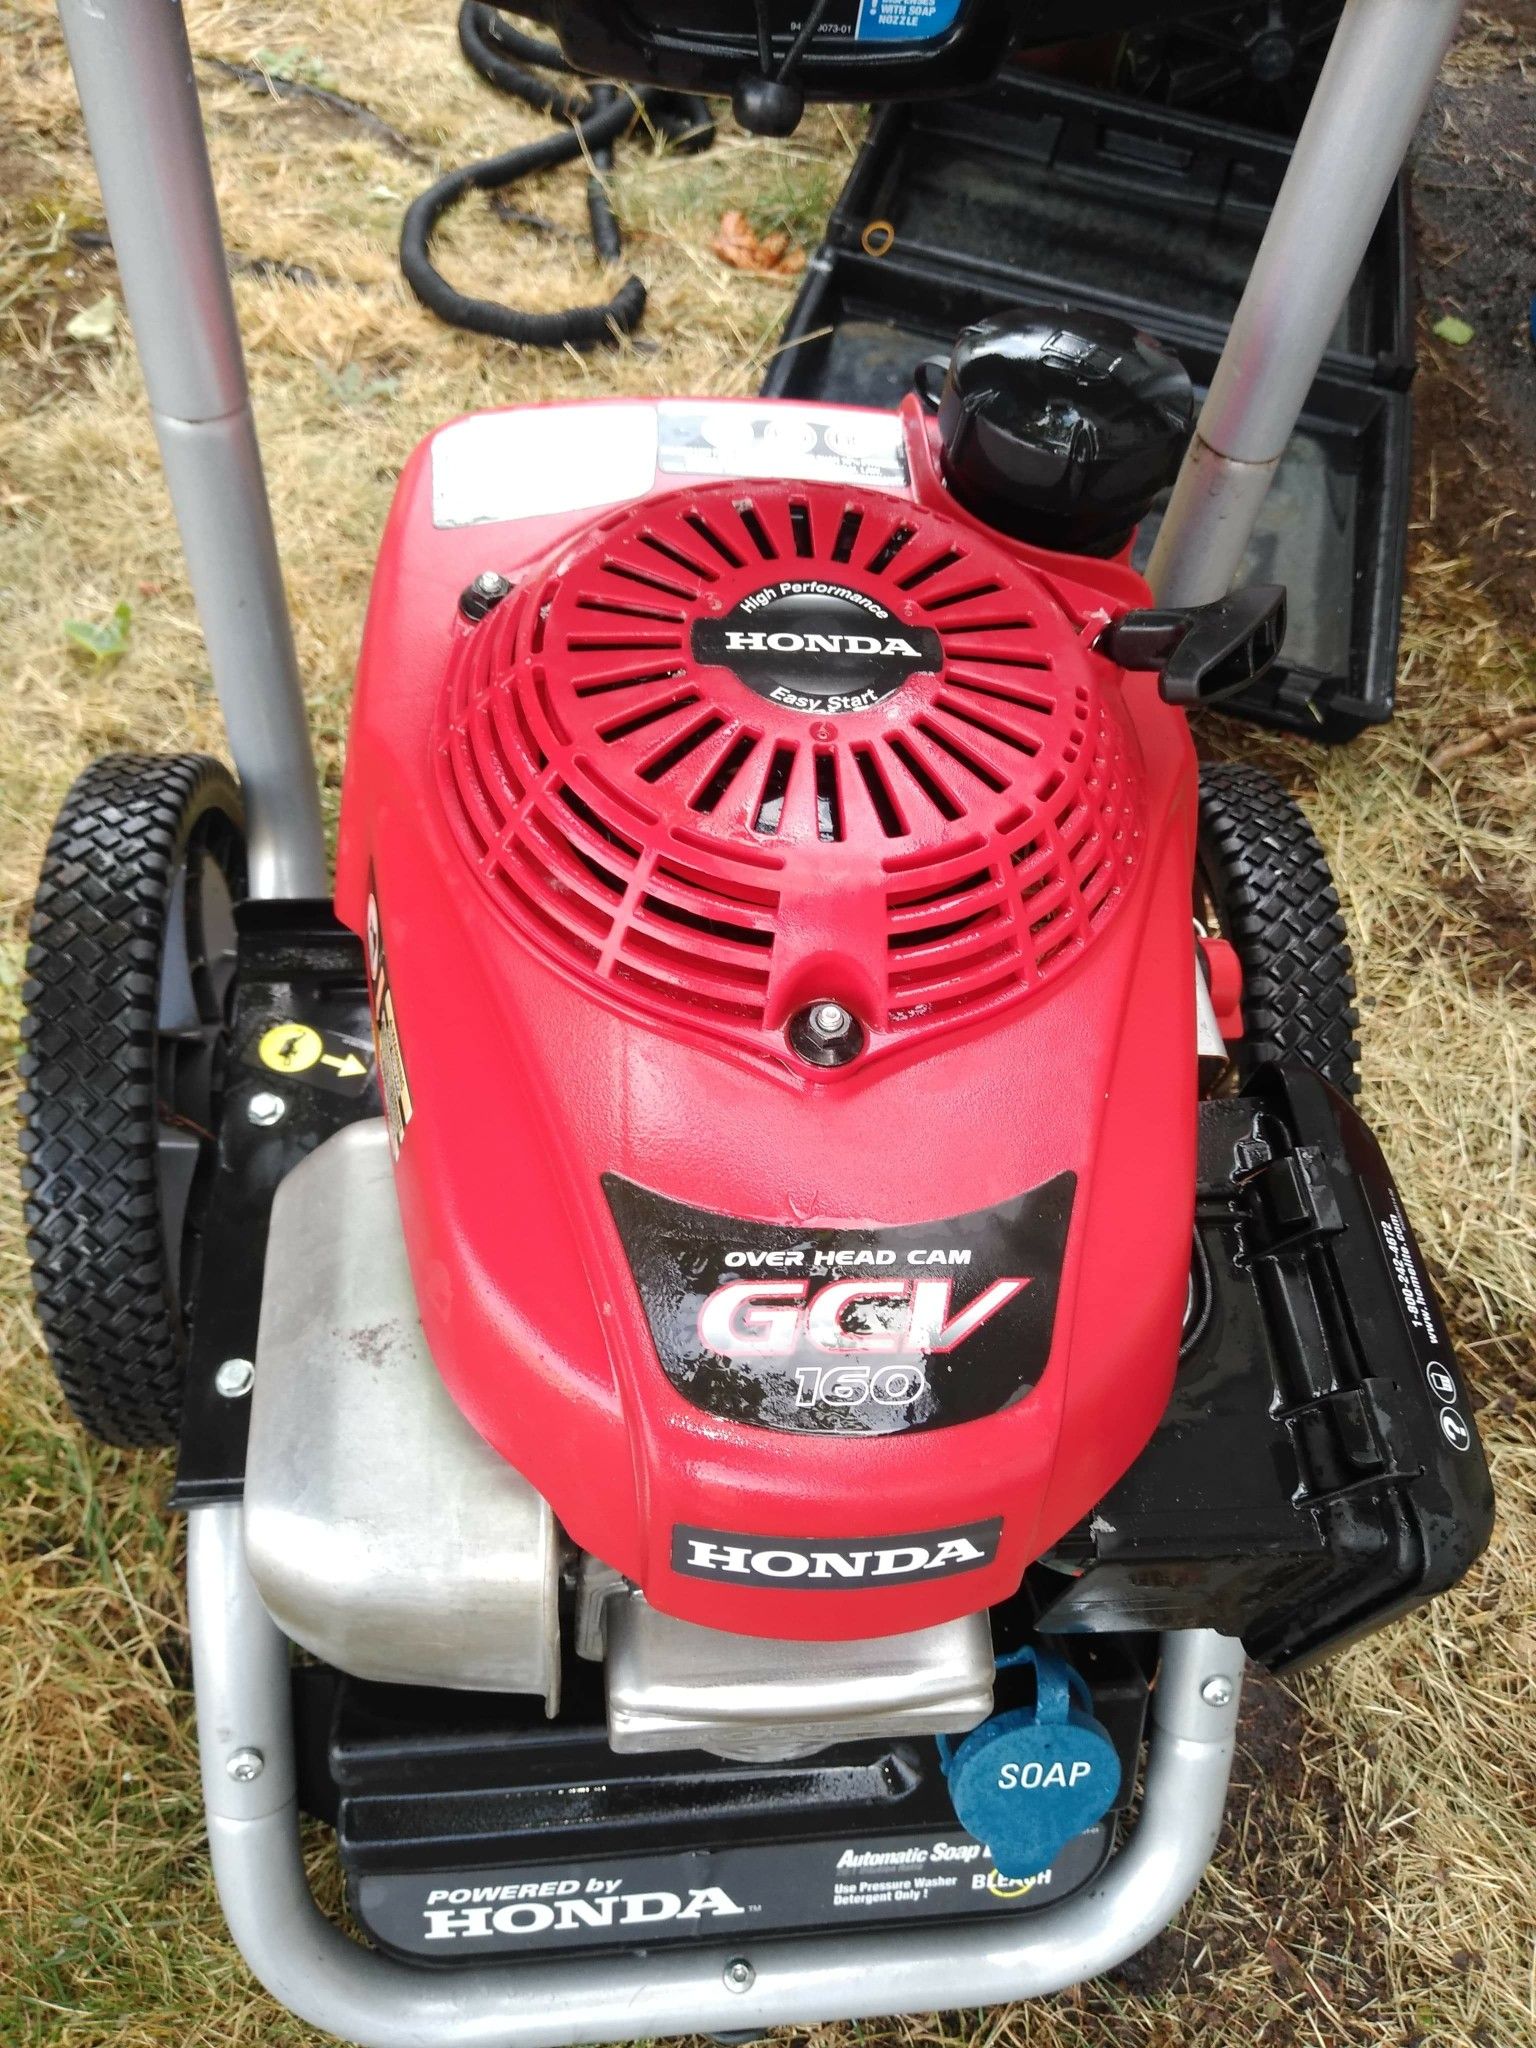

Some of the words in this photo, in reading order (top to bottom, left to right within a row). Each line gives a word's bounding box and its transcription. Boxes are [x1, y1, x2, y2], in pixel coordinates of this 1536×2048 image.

[878, 14, 919, 26] NOZZLE
[881, 4, 906, 15] WITH
[908, 5, 936, 17] SOAP
[740, 588, 777, 614] High
[779, 581, 889, 620] Performance
[725, 632, 922, 657] HONDA
[770, 686, 820, 712] Easy
[827, 688, 878, 711] Start
[724, 1250, 804, 1267] OVER
[814, 1250, 896, 1266] HEAD
[907, 1249, 972, 1265] CAM
[1380, 1220, 1423, 1327] 1-800-242-4672
[1389, 1213, 1439, 1344] www.homelite.com
[698, 1277, 1034, 1356] GCV
[794, 1365, 926, 1407] 160
[687, 1538, 985, 1578] HONDA
[998, 1762, 1091, 1790] SOAP
[836, 1848, 929, 1868] Automatic
[930, 1842, 981, 1864] Soap
[427, 1880, 581, 1905] POWERED
[585, 1878, 623, 1895] by
[833, 1891, 893, 1906] Detergent
[894, 1889, 920, 1902] Only
[834, 1884, 857, 1895] Use
[859, 1879, 912, 1893] Pressure
[914, 1876, 958, 1888] Washer
[423, 1886, 745, 1939] HONDA
